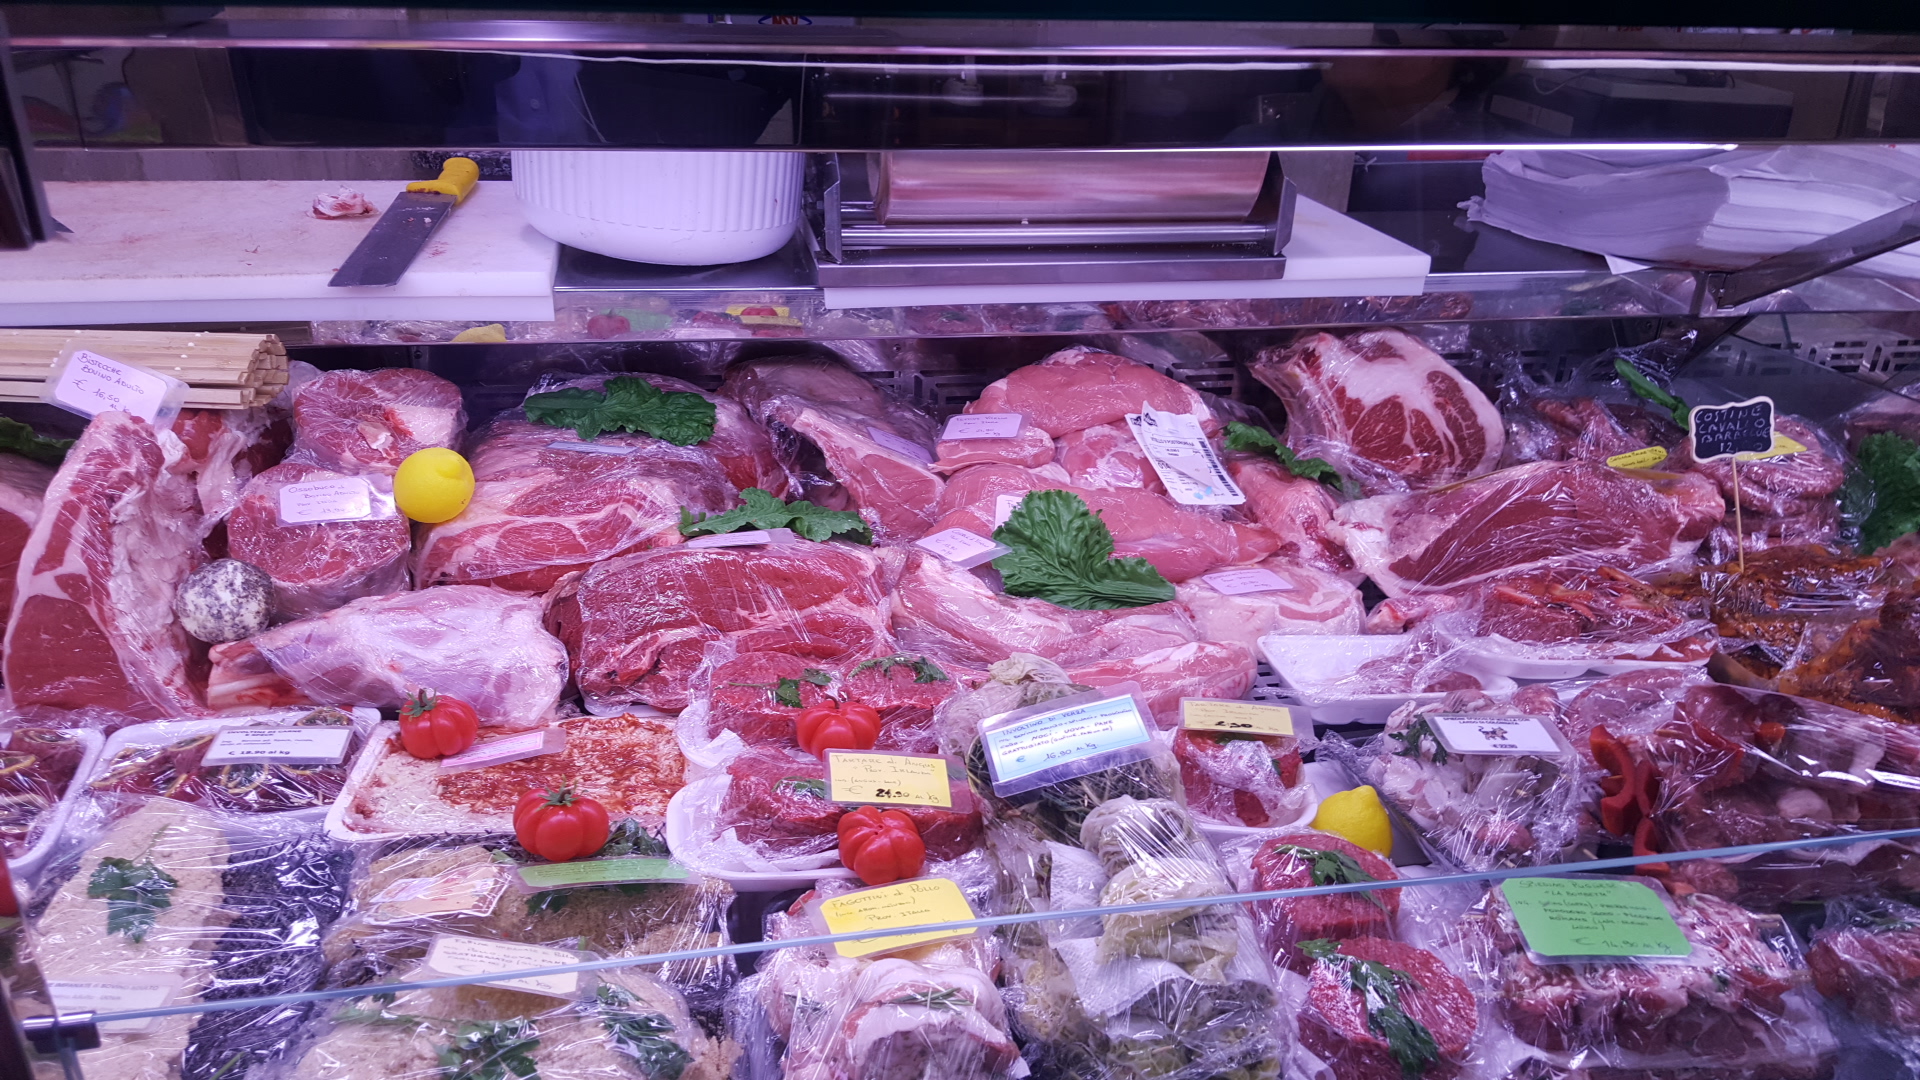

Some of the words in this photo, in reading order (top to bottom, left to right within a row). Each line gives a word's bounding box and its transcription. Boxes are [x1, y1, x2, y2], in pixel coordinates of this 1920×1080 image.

[72, 378, 88, 391] €
[80, 364, 112, 382] BOVINO
[114, 378, 145, 395] ADULTO
[1695, 404, 1763, 424] COSTINE
[1002, 719, 1043, 737] INVOLTINO
[1064, 725, 1085, 734] UOVA
[1094, 719, 1114, 727] PANE
[833, 755, 882, 765] TARTARE
[1015, 755, 1026, 763] €
[831, 891, 888, 909] FAGOTTINI
[908, 883, 940, 893] POLLO
